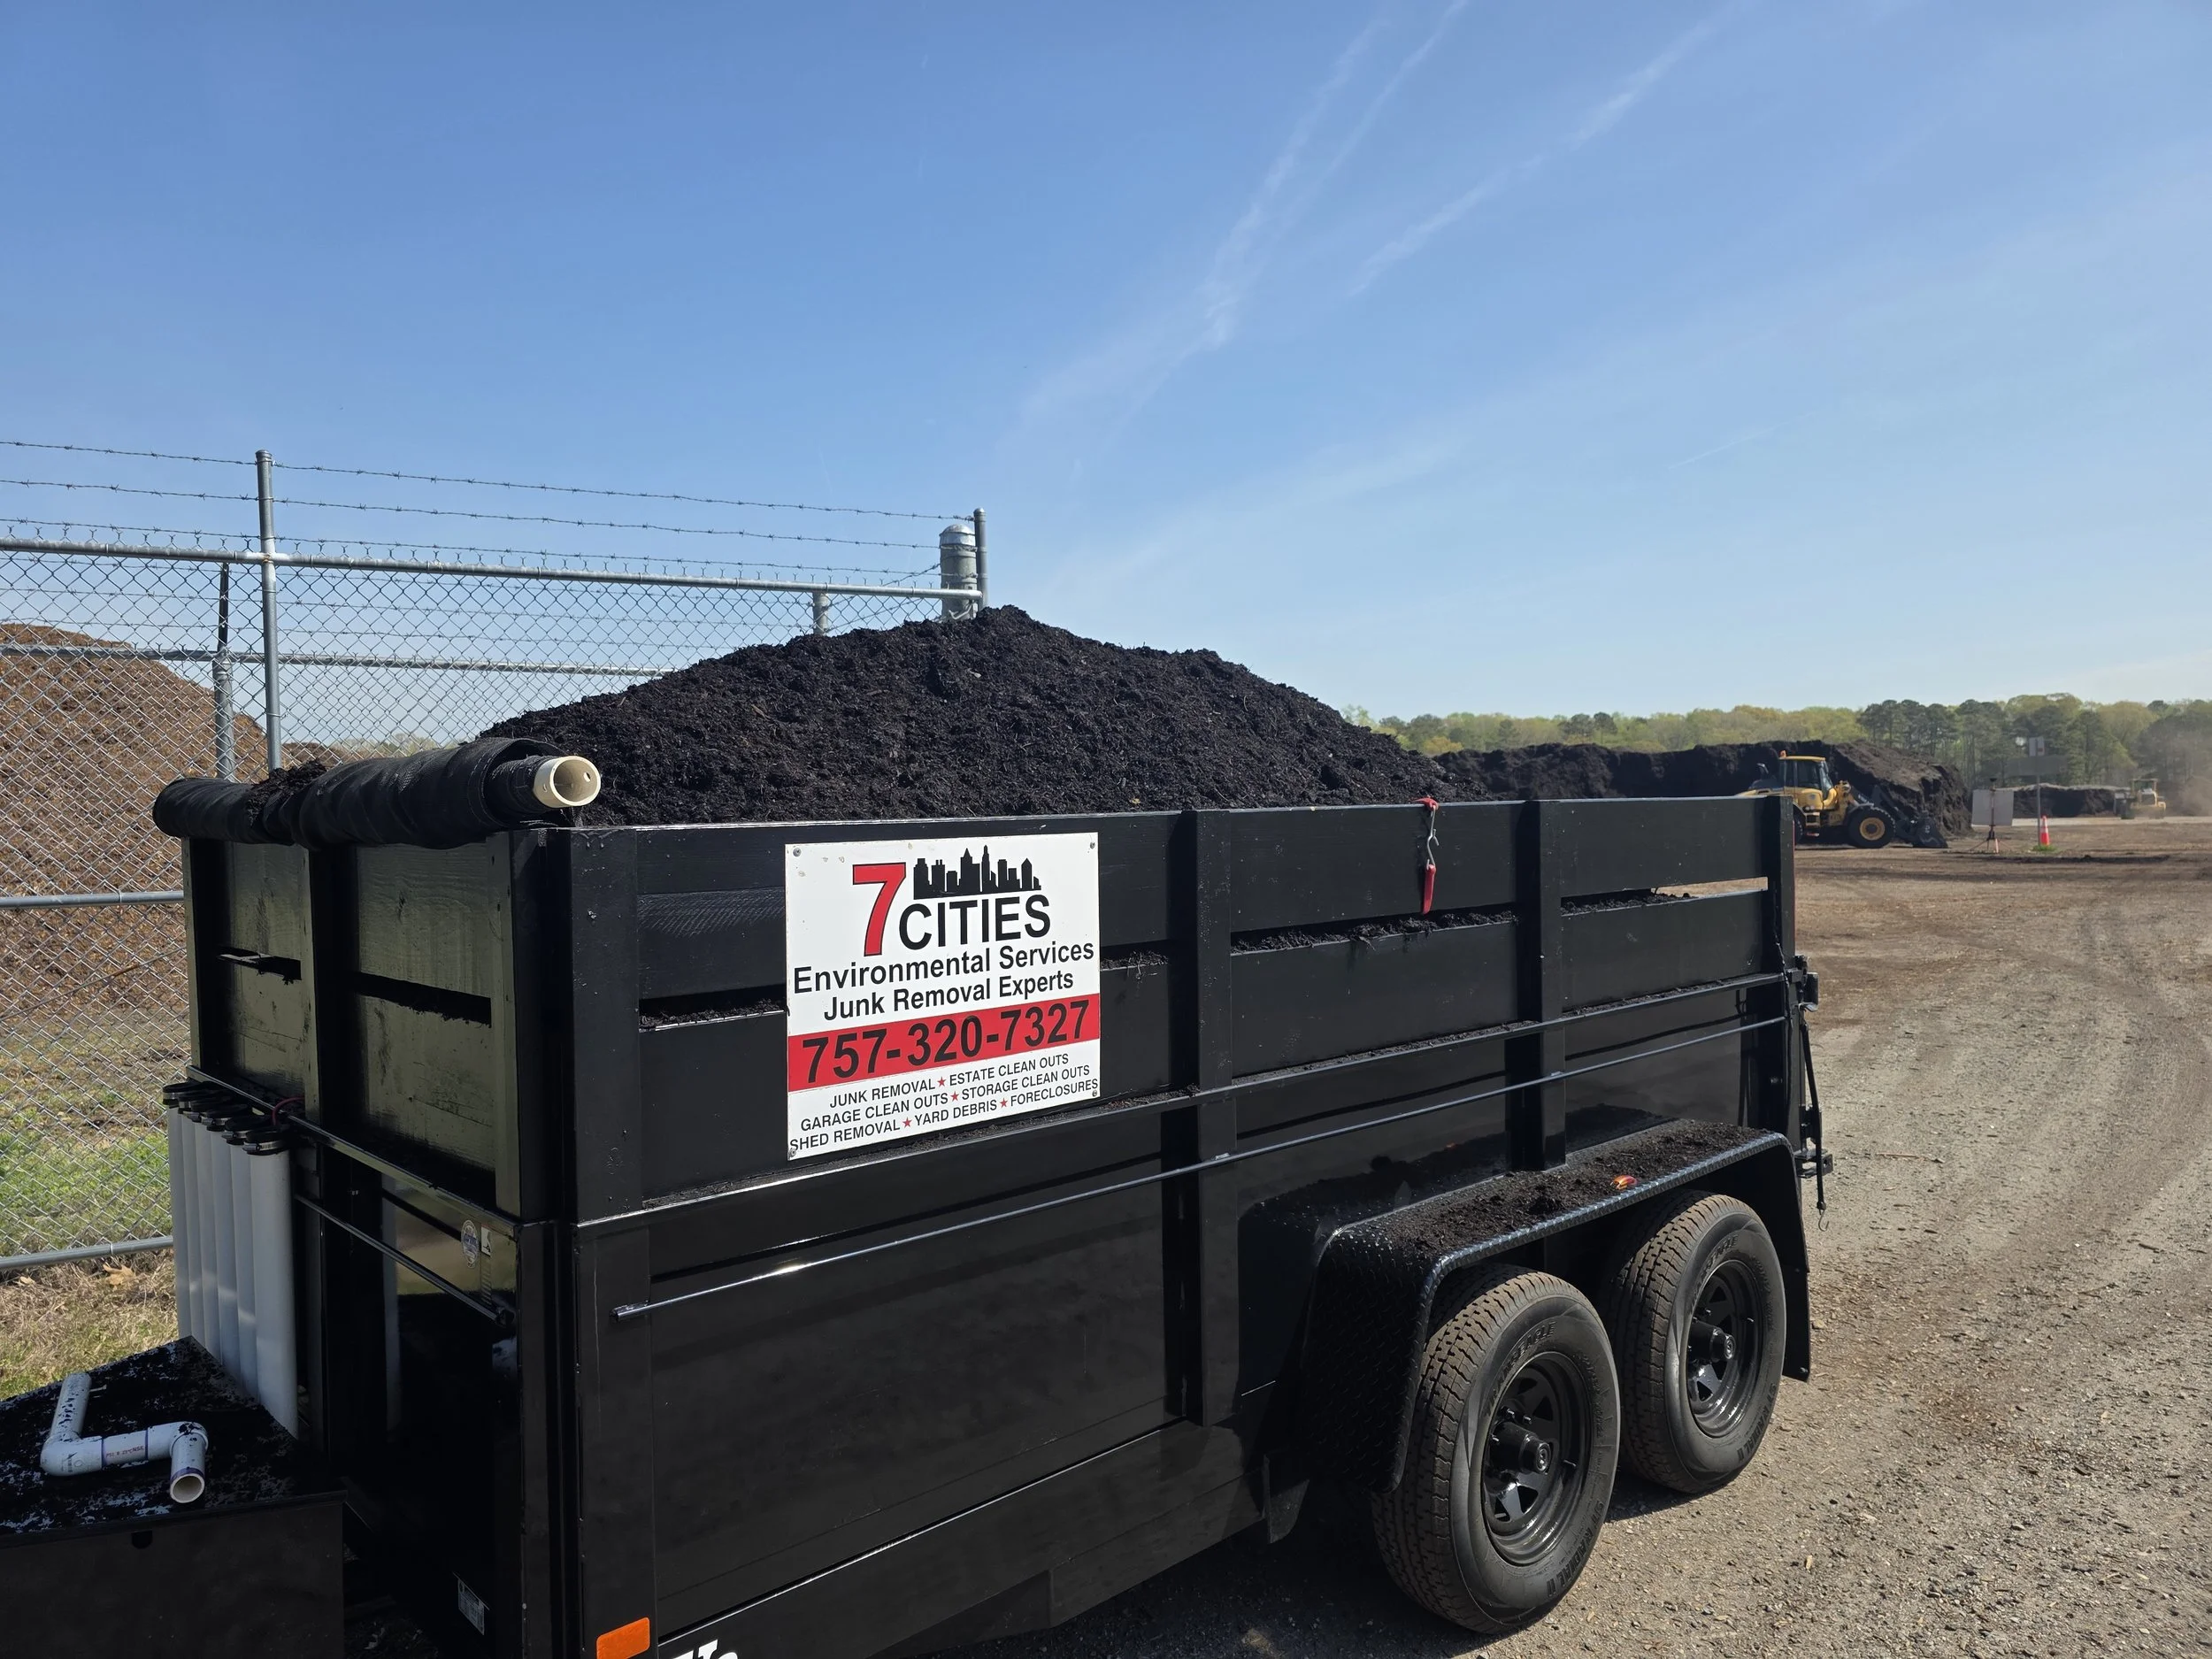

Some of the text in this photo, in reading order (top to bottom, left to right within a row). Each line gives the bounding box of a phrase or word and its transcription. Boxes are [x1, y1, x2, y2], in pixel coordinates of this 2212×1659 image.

[852, 862, 1050, 957] 7 CITIES
[795, 941, 1094, 994] Environmental Services
[824, 971, 1073, 1020] Junk Removal Experts
[803, 1000, 1089, 1083] 757-320-7327
[801, 1064, 1090, 1132] GARAGE CLEAN OUTS STORAGE CLEAN OUTS
[830, 1053, 1069, 1108] JUNK REMOVAL ESTATE CLEAN OUTS
[789, 1079, 1098, 1151] SHED REMOVAL YARD DEBRIS FORECLOSURES
[1556, 1526, 1594, 1588] RADIAL
